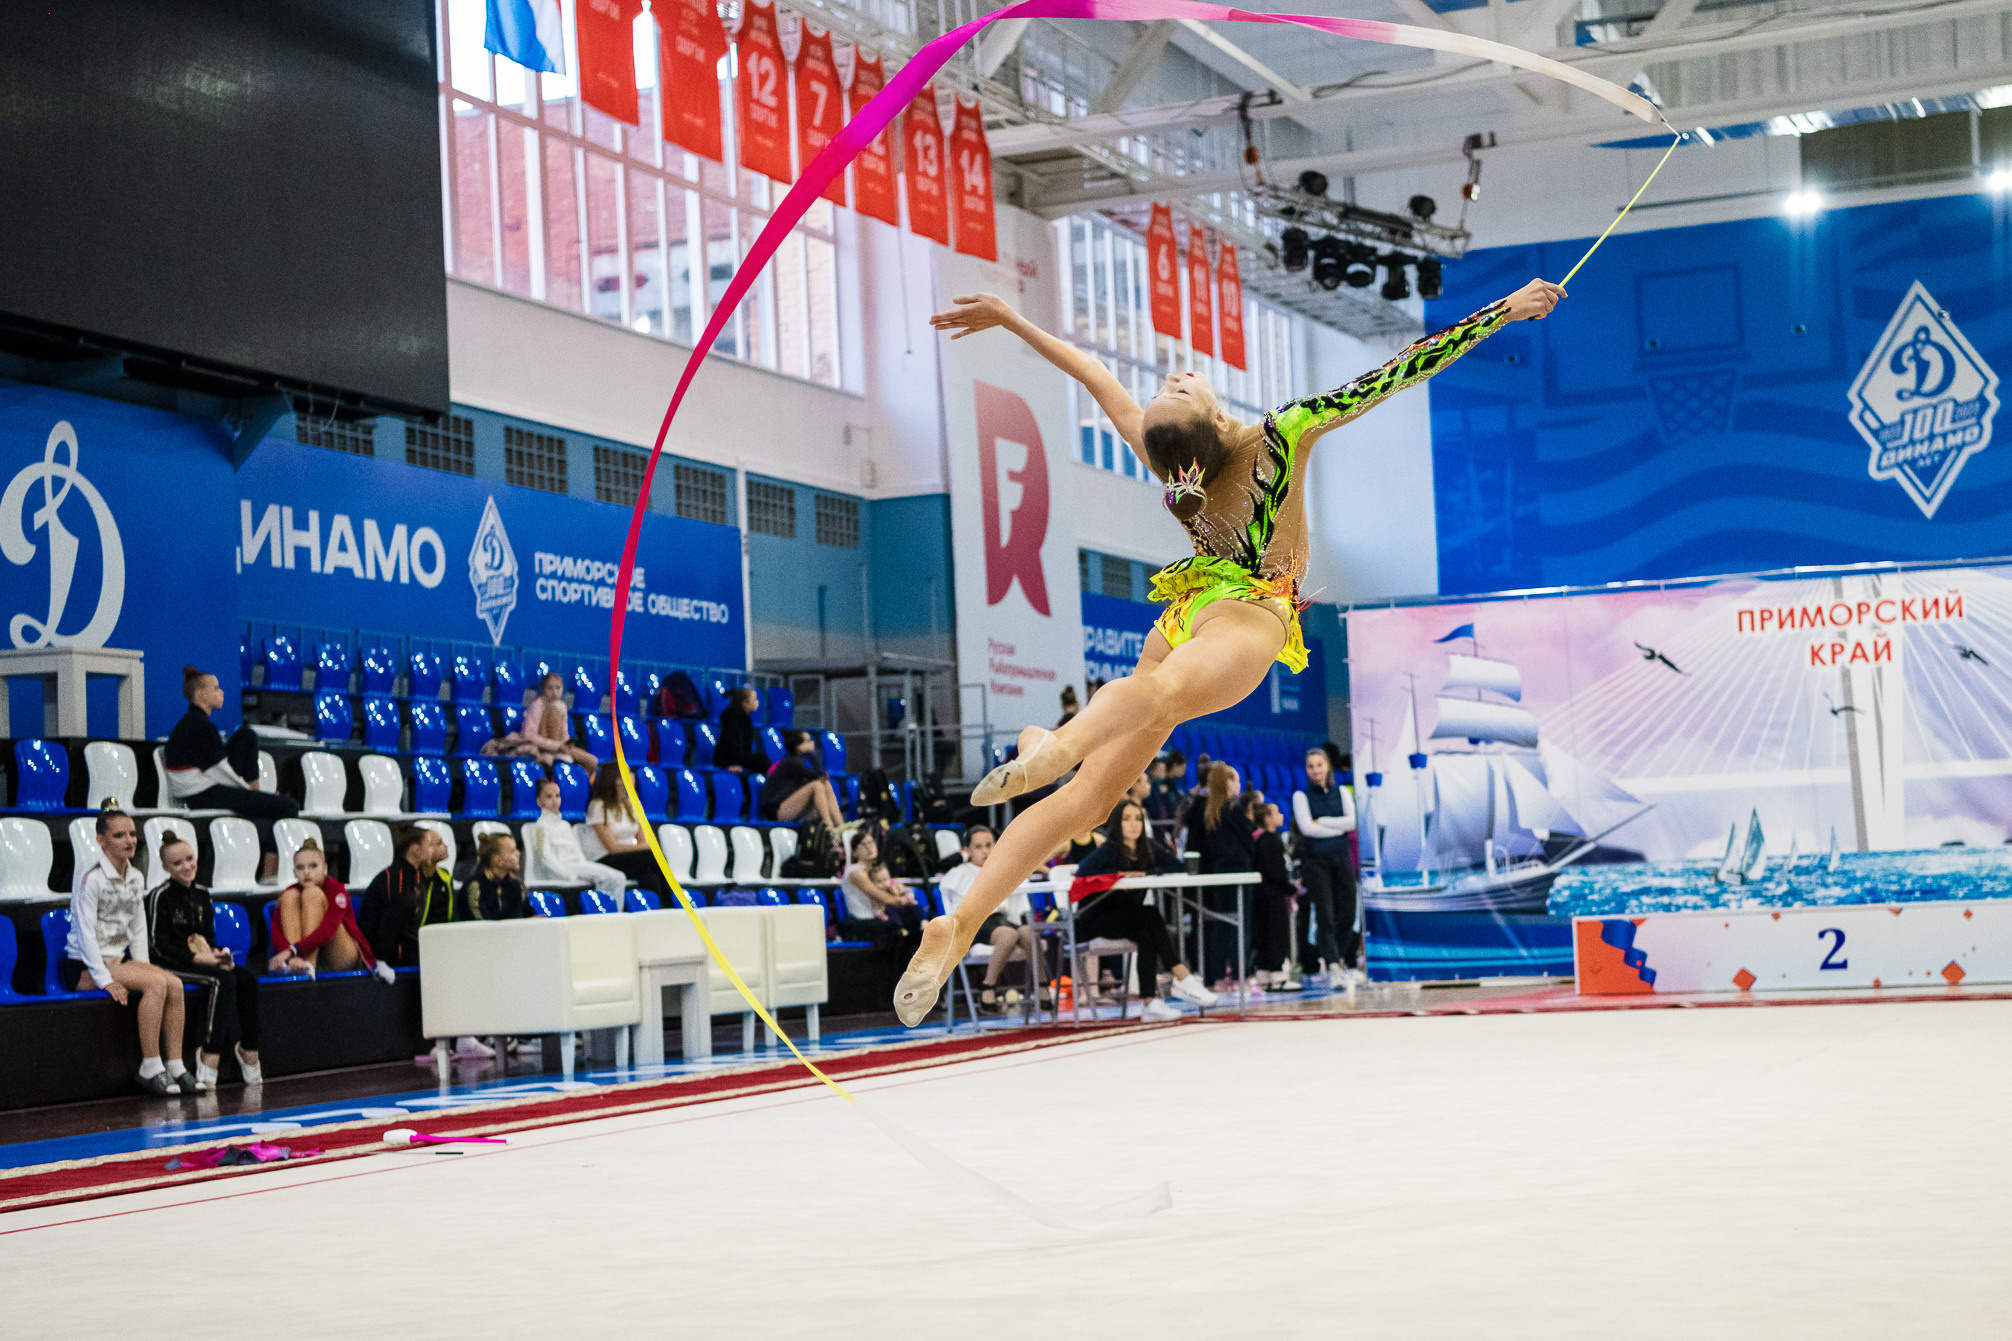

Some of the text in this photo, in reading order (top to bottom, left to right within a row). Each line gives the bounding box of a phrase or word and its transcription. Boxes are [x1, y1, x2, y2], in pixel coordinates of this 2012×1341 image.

[746, 52, 778, 108] 12
[810, 80, 828, 126] 7
[913, 130, 938, 177] 13
[960, 150, 985, 195] 14
[236, 499, 446, 589] ИНАМО
[647, 593, 729, 624] ОБЩЕСТВО
[1737, 589, 1964, 633] ПРИМОРСКИЙ
[1810, 633, 1893, 667] КРАЙ
[1818, 928, 1848, 970] 2
